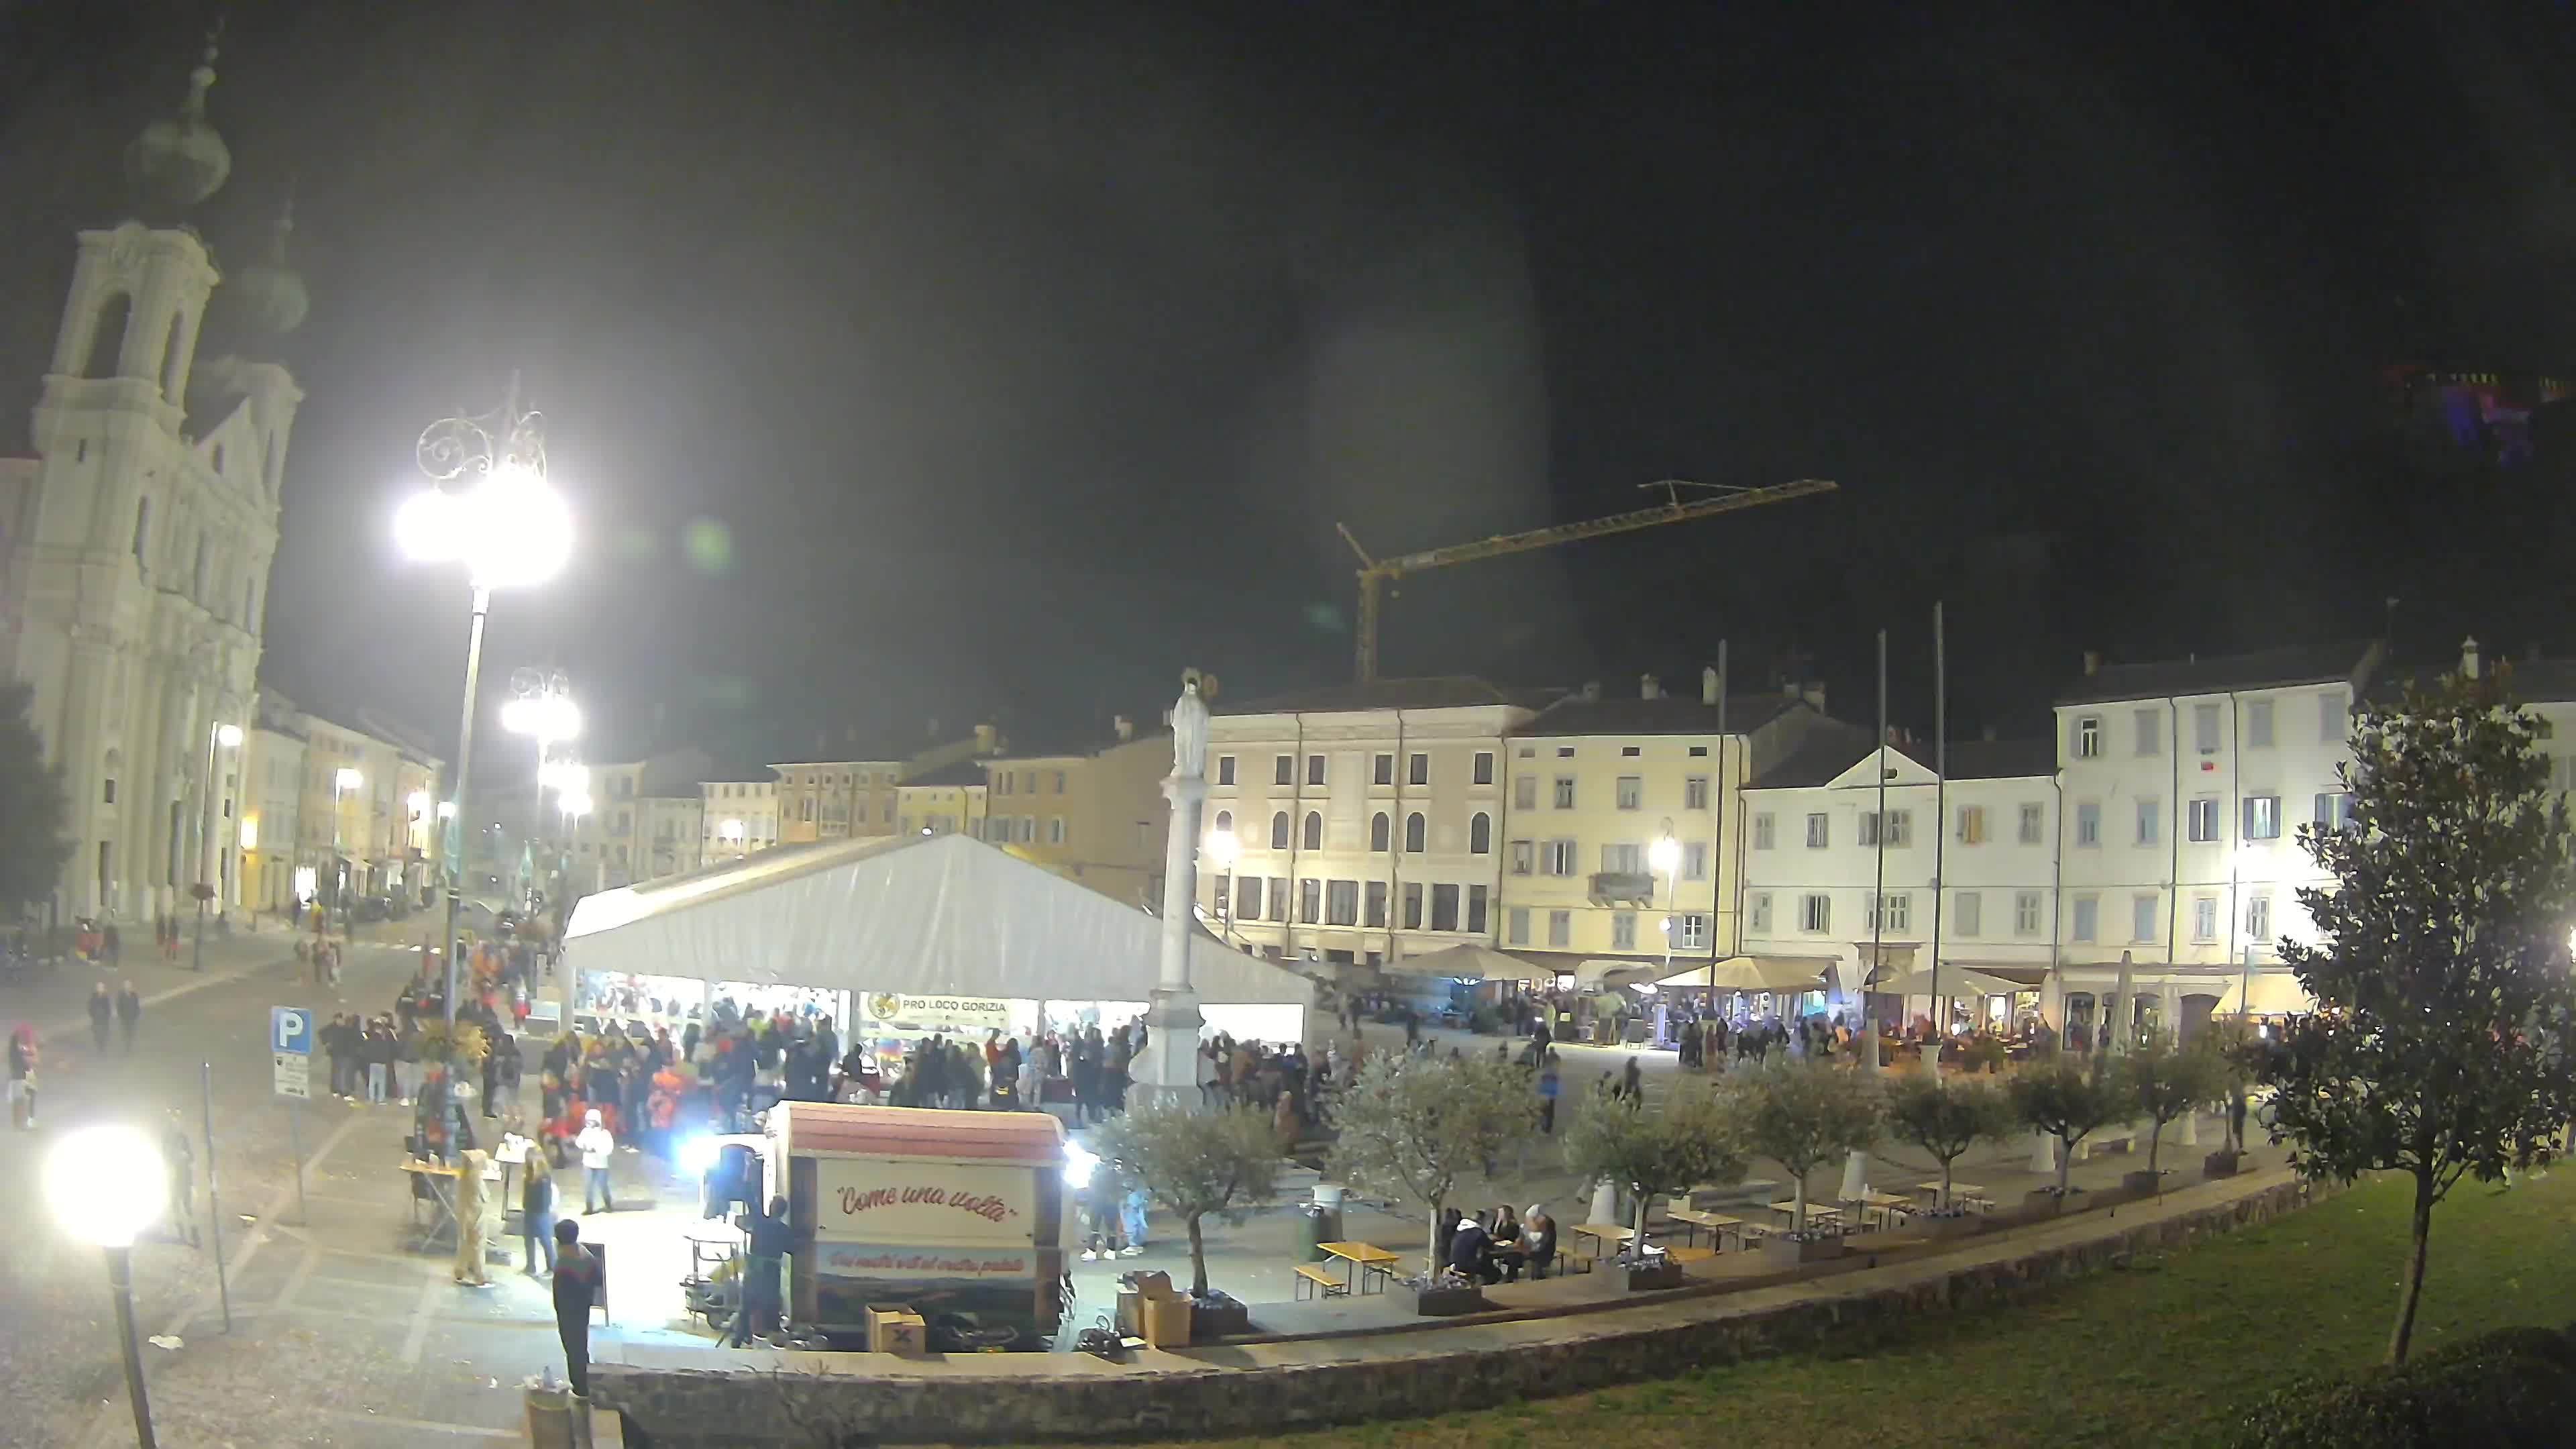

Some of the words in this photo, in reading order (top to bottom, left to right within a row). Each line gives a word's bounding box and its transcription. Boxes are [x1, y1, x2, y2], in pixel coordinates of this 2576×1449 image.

[903, 1000, 926, 1010] PRO
[928, 1000, 959, 1010] LOCO
[961, 1002, 1007, 1012] GORIZIA
[279, 1012, 304, 1047] P
[902, 1186, 945, 1205] una
